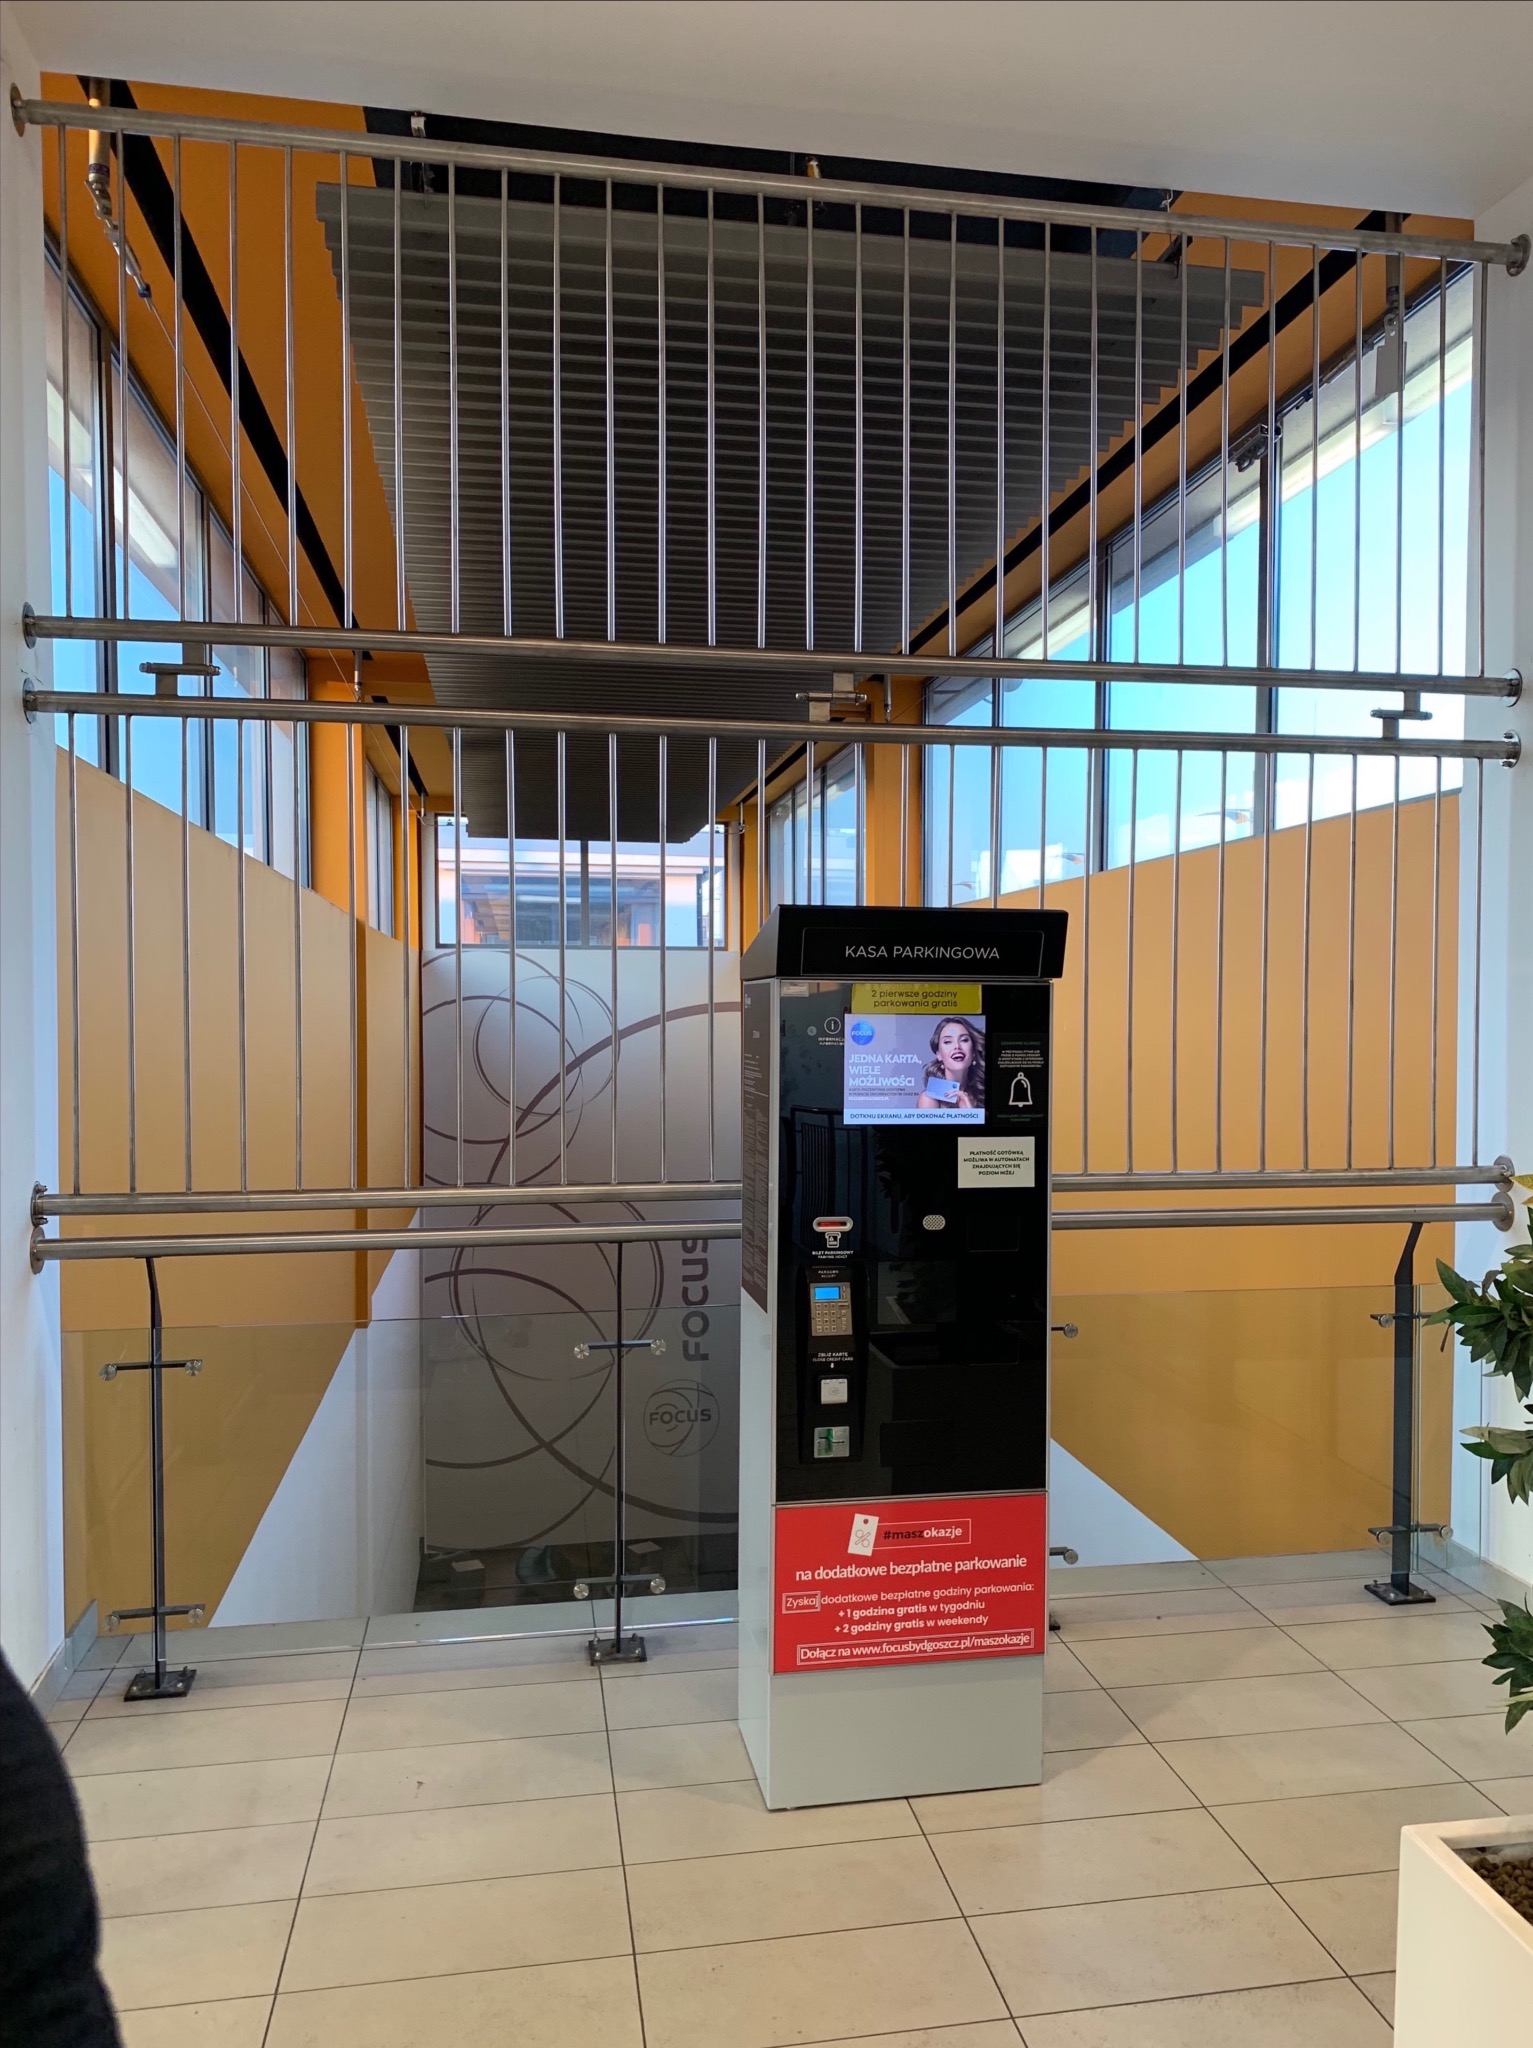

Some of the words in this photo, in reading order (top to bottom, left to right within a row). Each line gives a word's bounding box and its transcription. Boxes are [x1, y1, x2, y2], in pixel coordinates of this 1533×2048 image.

[845, 945, 888, 959] KASA
[893, 946, 1000, 960] PARKINGOWA
[871, 990, 877, 998] 2
[879, 990, 919, 1000] pierwsze
[921, 990, 958, 1000] godziny
[873, 998, 929, 1008] parkowania
[931, 1000, 958, 1009] gratis
[848, 1054, 884, 1064] JEDNA
[885, 1055, 922, 1065] KARTA,
[849, 1065, 881, 1075] WIELE
[849, 1075, 915, 1087] MOŻLIWOŚCI
[650, 1408, 712, 1426] FOCUS
[883, 1525, 963, 1540] #maszokazje
[796, 1569, 812, 1581] na
[815, 1564, 887, 1580] dodatkowe
[890, 1559, 952, 1577] bezpłatne
[955, 1554, 1027, 1573] parkowanie
[786, 1596, 819, 1609] Zyskaj
[821, 1592, 878, 1604] dodatkowe
[881, 1588, 931, 1602] bezpłatne
[933, 1585, 971, 1600] godziny
[974, 1582, 1035, 1597] parkowania:
[853, 1604, 895, 1620] godzina
[897, 1602, 927, 1617] gratis
[940, 1600, 985, 1614] tygodniu
[843, 1624, 849, 1633] 2
[851, 1619, 892, 1635] godziny
[894, 1617, 924, 1632] gratis
[926, 1619, 935, 1627] w
[937, 1614, 989, 1626] weekendy
[800, 1647, 837, 1660] Dołącz
[838, 1646, 851, 1656] na
[852, 1632, 1030, 1654] www.focusbydgoszcz.pl/maszokazje
